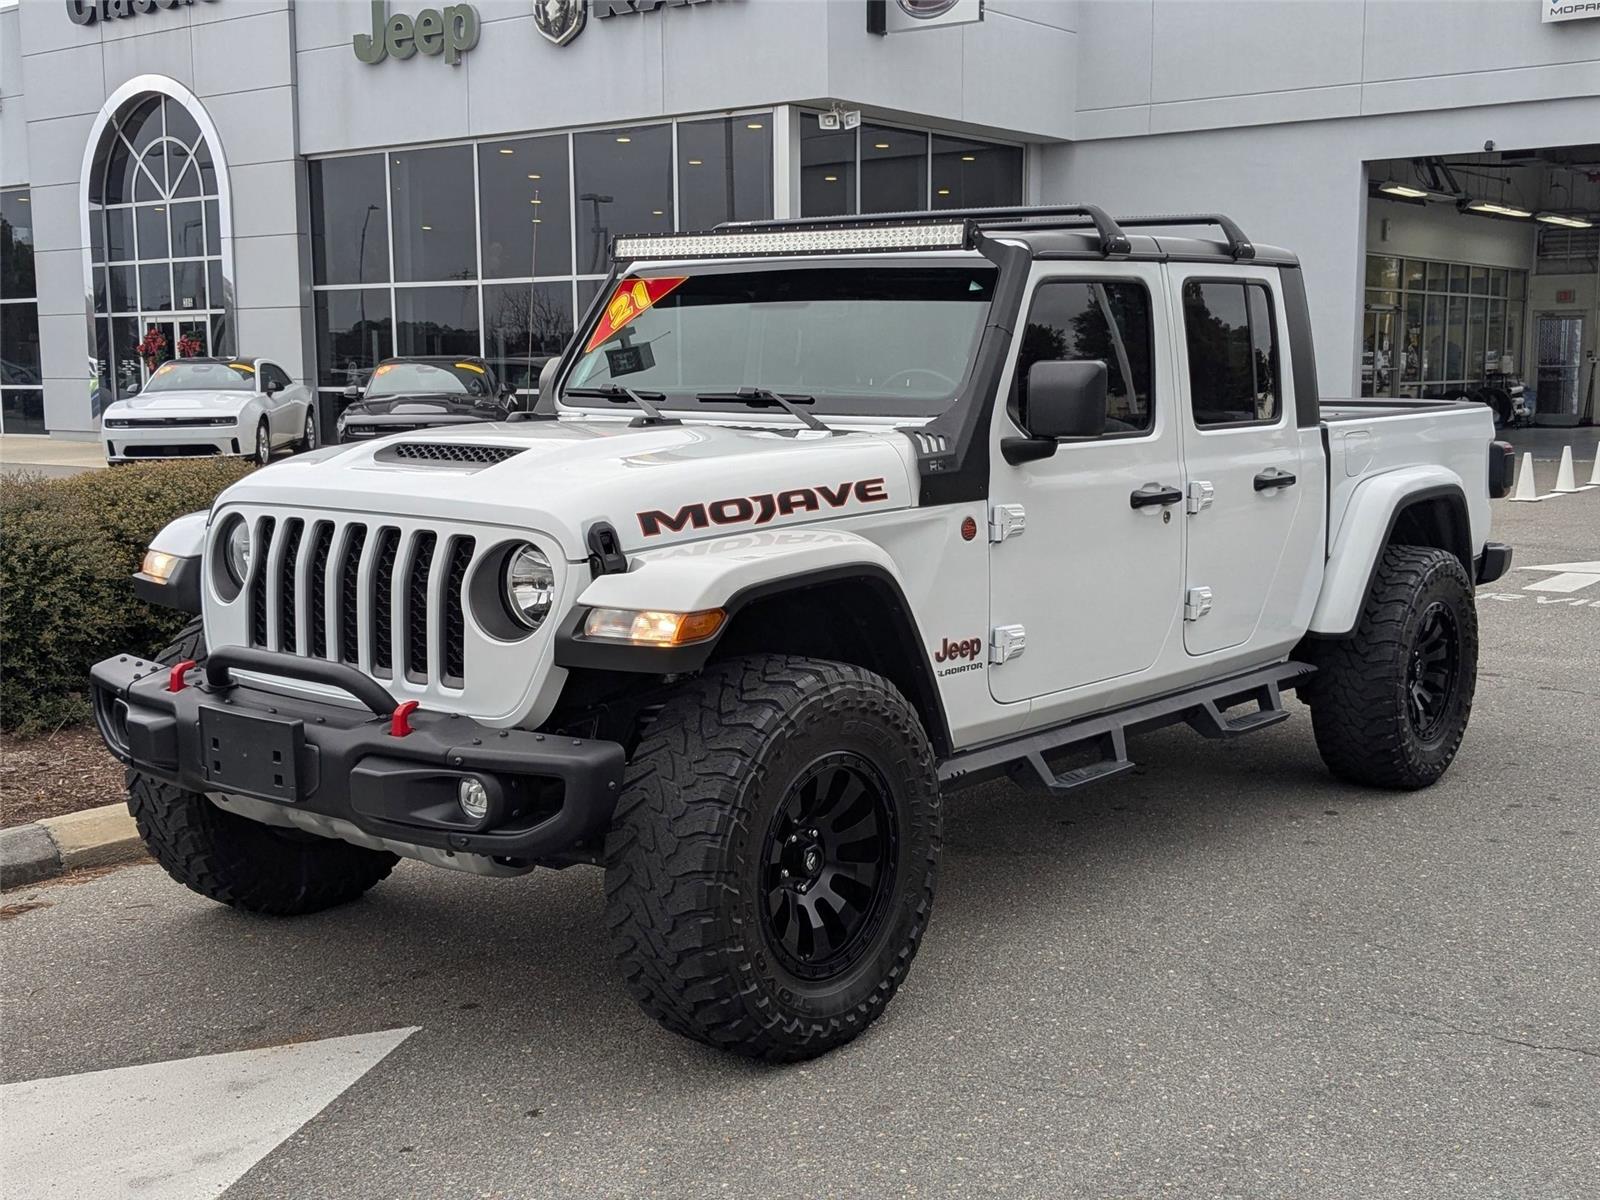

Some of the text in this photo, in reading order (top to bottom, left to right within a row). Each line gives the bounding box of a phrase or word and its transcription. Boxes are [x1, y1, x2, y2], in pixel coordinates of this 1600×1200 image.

[353, 0, 480, 65] Jeep
[1550, 2, 1600, 15] MOPA
[608, 280, 652, 330] 21
[637, 478, 888, 537] MOJAVE
[934, 637, 982, 663] Jeep
